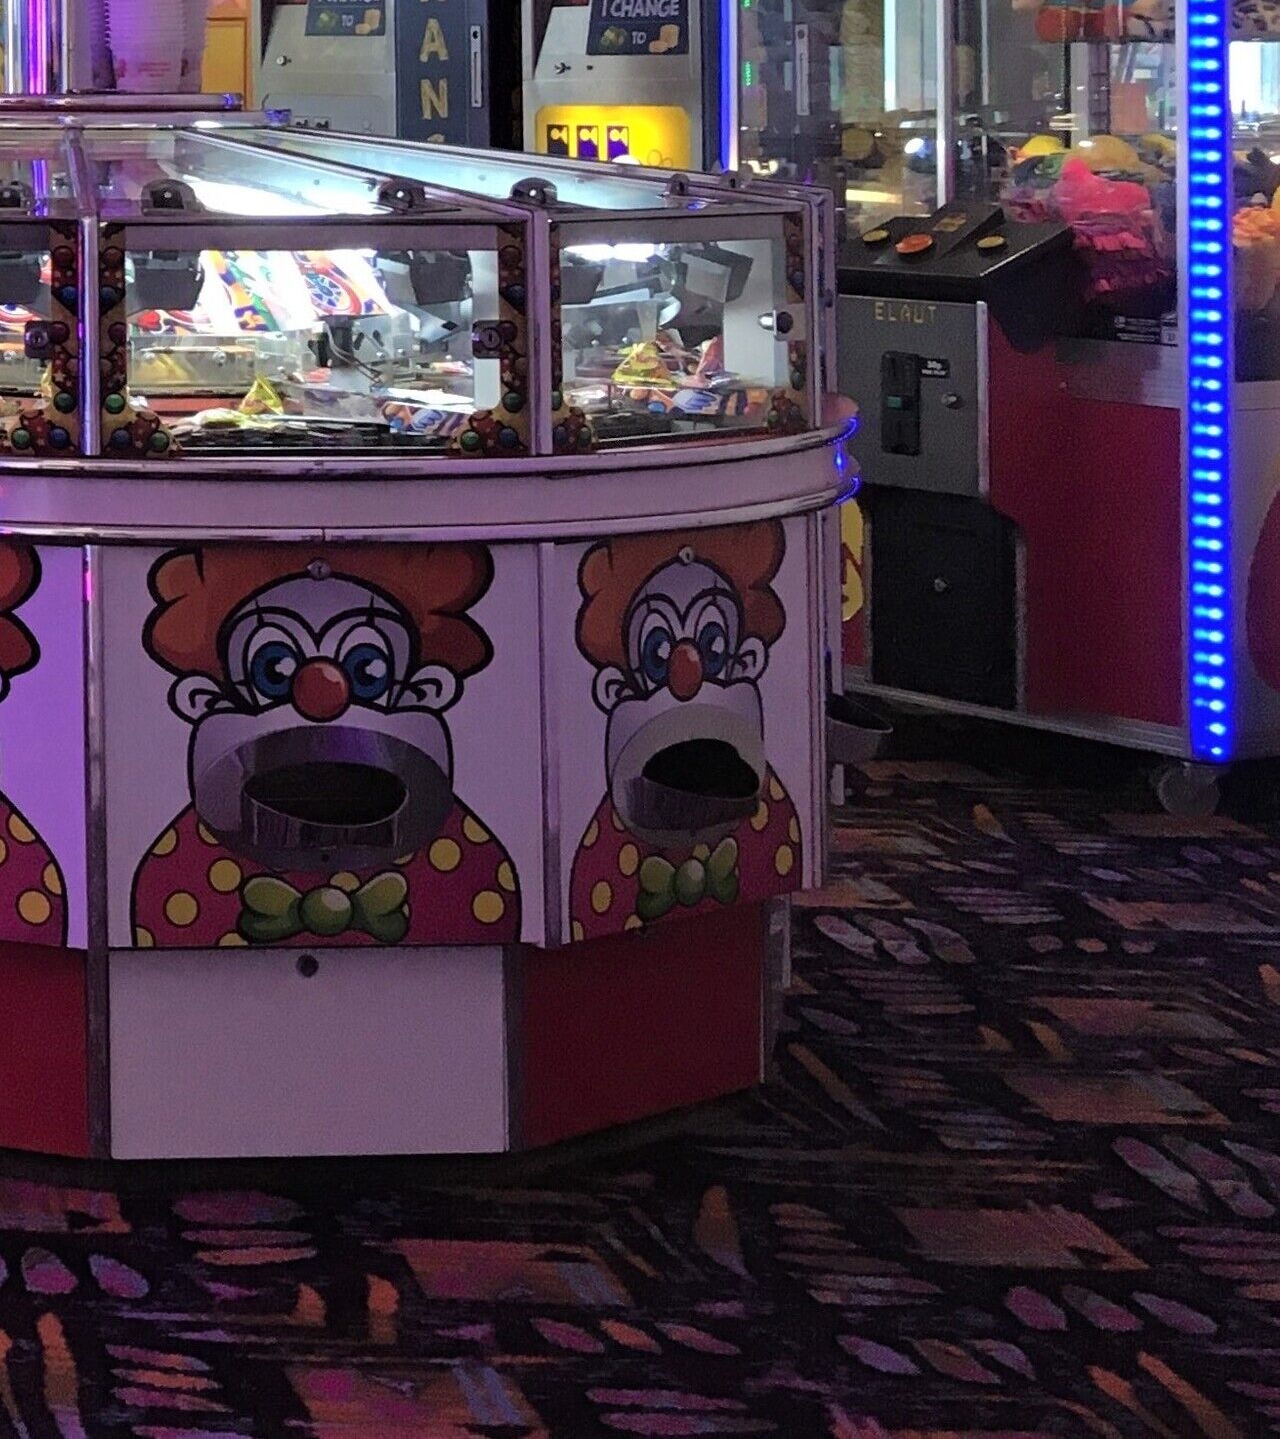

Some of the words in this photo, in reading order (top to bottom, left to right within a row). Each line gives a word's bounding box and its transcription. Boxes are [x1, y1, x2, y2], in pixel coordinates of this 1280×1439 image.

[601, 0, 608, 17] I
[342, 14, 355, 27] TO
[631, 31, 646, 44] TO
[875, 302, 937, 325] ELAUT
